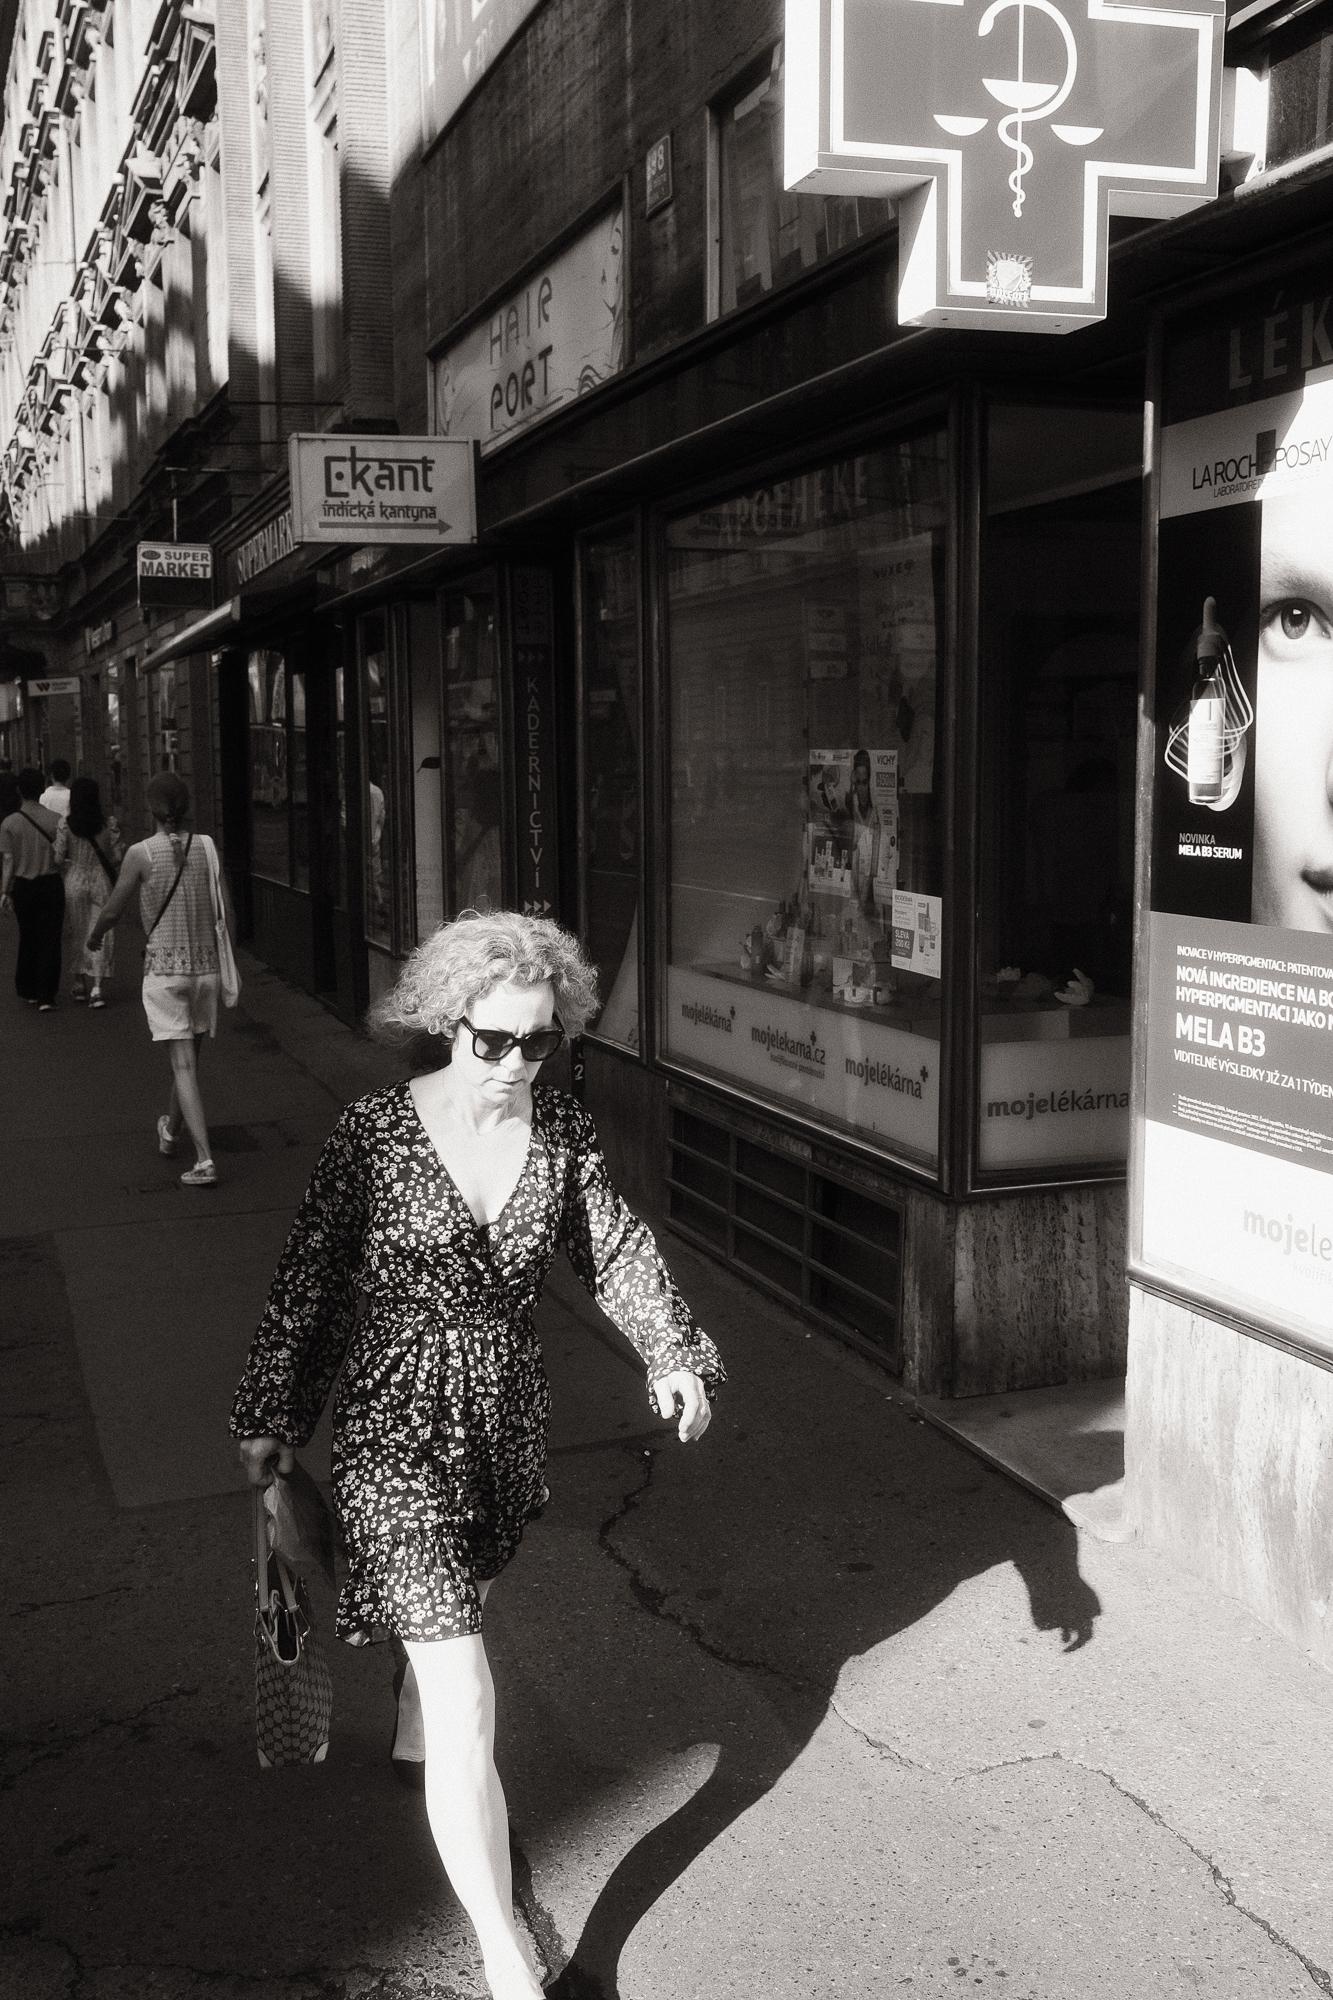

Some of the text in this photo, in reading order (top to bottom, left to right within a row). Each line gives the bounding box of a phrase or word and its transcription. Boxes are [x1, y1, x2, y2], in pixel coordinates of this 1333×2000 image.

[489, 276, 553, 365] HAIR
[1228, 290, 1333, 390] LÉK
[490, 344, 554, 429] PORT
[1192, 464, 1213, 490] LA
[140, 561, 210, 578] MARKET
[164, 551, 209, 562] SUPER
[525, 676, 544, 889] KADEŘNICTVÍ
[1178, 844, 1243, 860] MELA B3 SERUM
[1179, 832, 1216, 845] NOVINKA
[1176, 945, 1208, 959] INOVACE
[1213, 950, 1287, 973] HYPERPIGMENTACI:
[1176, 964, 1209, 986] NOVÁ
[1209, 970, 1296, 1002] INGREDIENCE
[1296, 985, 1318, 1006] NA
[1175, 985, 1290, 1023] HYPERPIGMENTACI
[1292, 1007, 1327, 1030] JAKO
[1175, 1011, 1266, 1058] MELA B3
[845, 1057, 922, 1100] mojelékárna
[1173, 1048, 1218, 1070] VIDITELNÉ
[1218, 1058, 1266, 1081] VÝSLEDKY
[1265, 1069, 1281, 1086] JIŽ
[1280, 1074, 1296, 1090] ZA
[987, 1088, 1130, 1121] mojelékárna
